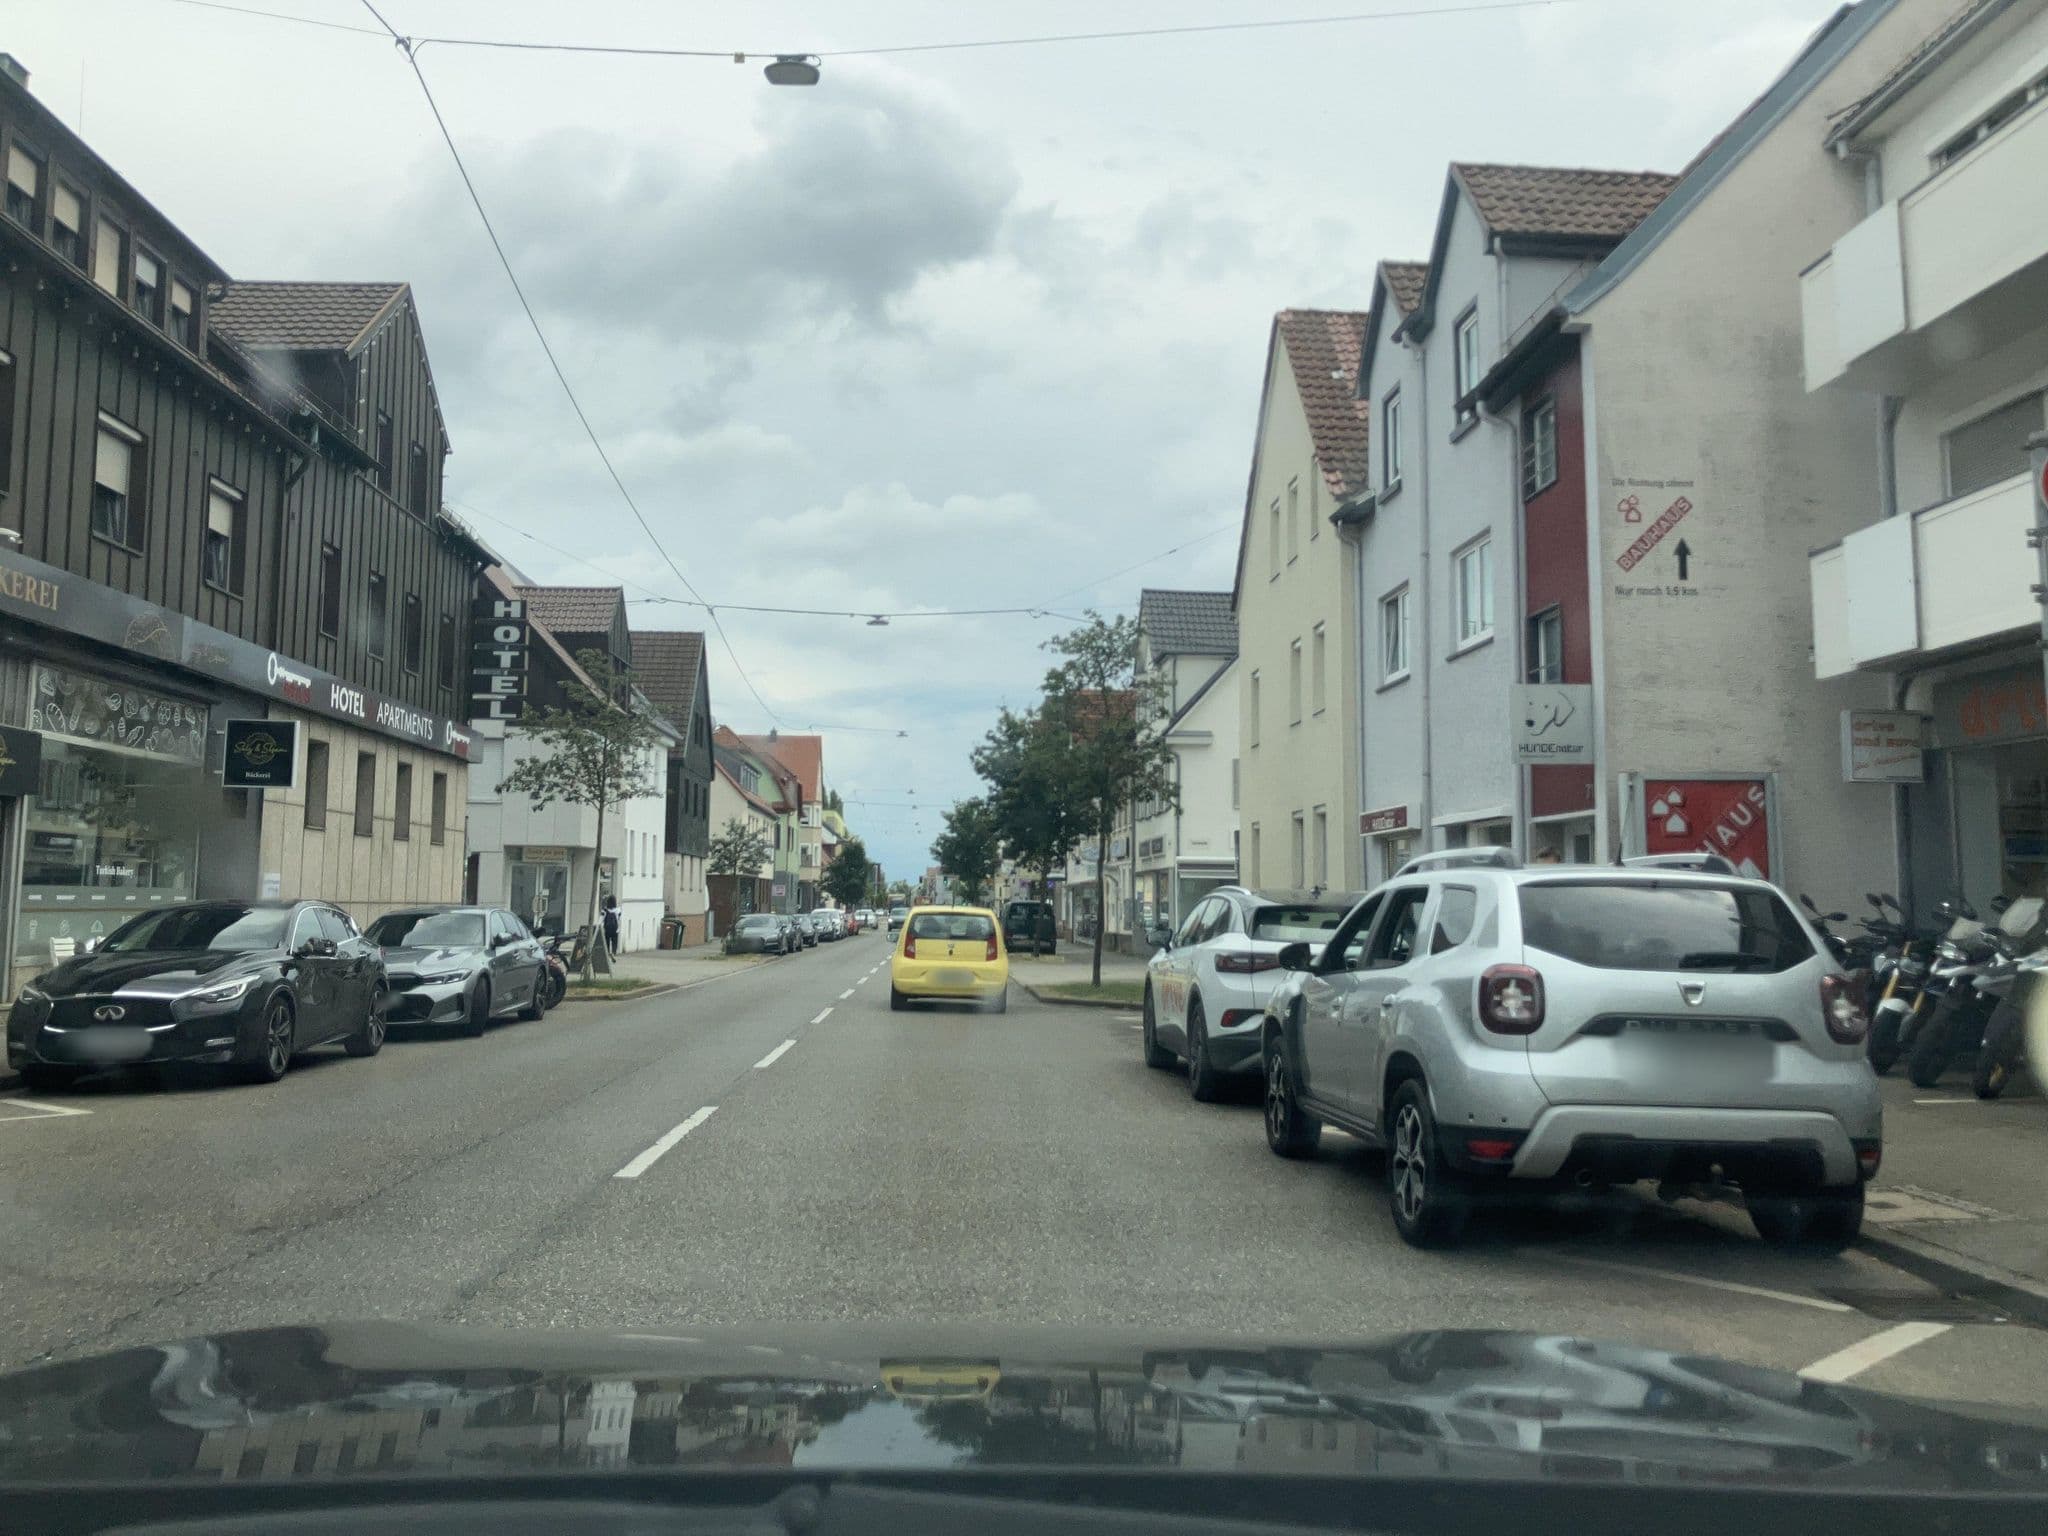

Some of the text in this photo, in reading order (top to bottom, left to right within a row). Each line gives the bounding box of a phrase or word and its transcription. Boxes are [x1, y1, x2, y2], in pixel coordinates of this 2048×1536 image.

[1618, 497, 1691, 571] BAUHAUS
[490, 600, 521, 718] HOTEL
[330, 683, 365, 718] HOTEL
[376, 701, 433, 740] APARTMENTS
